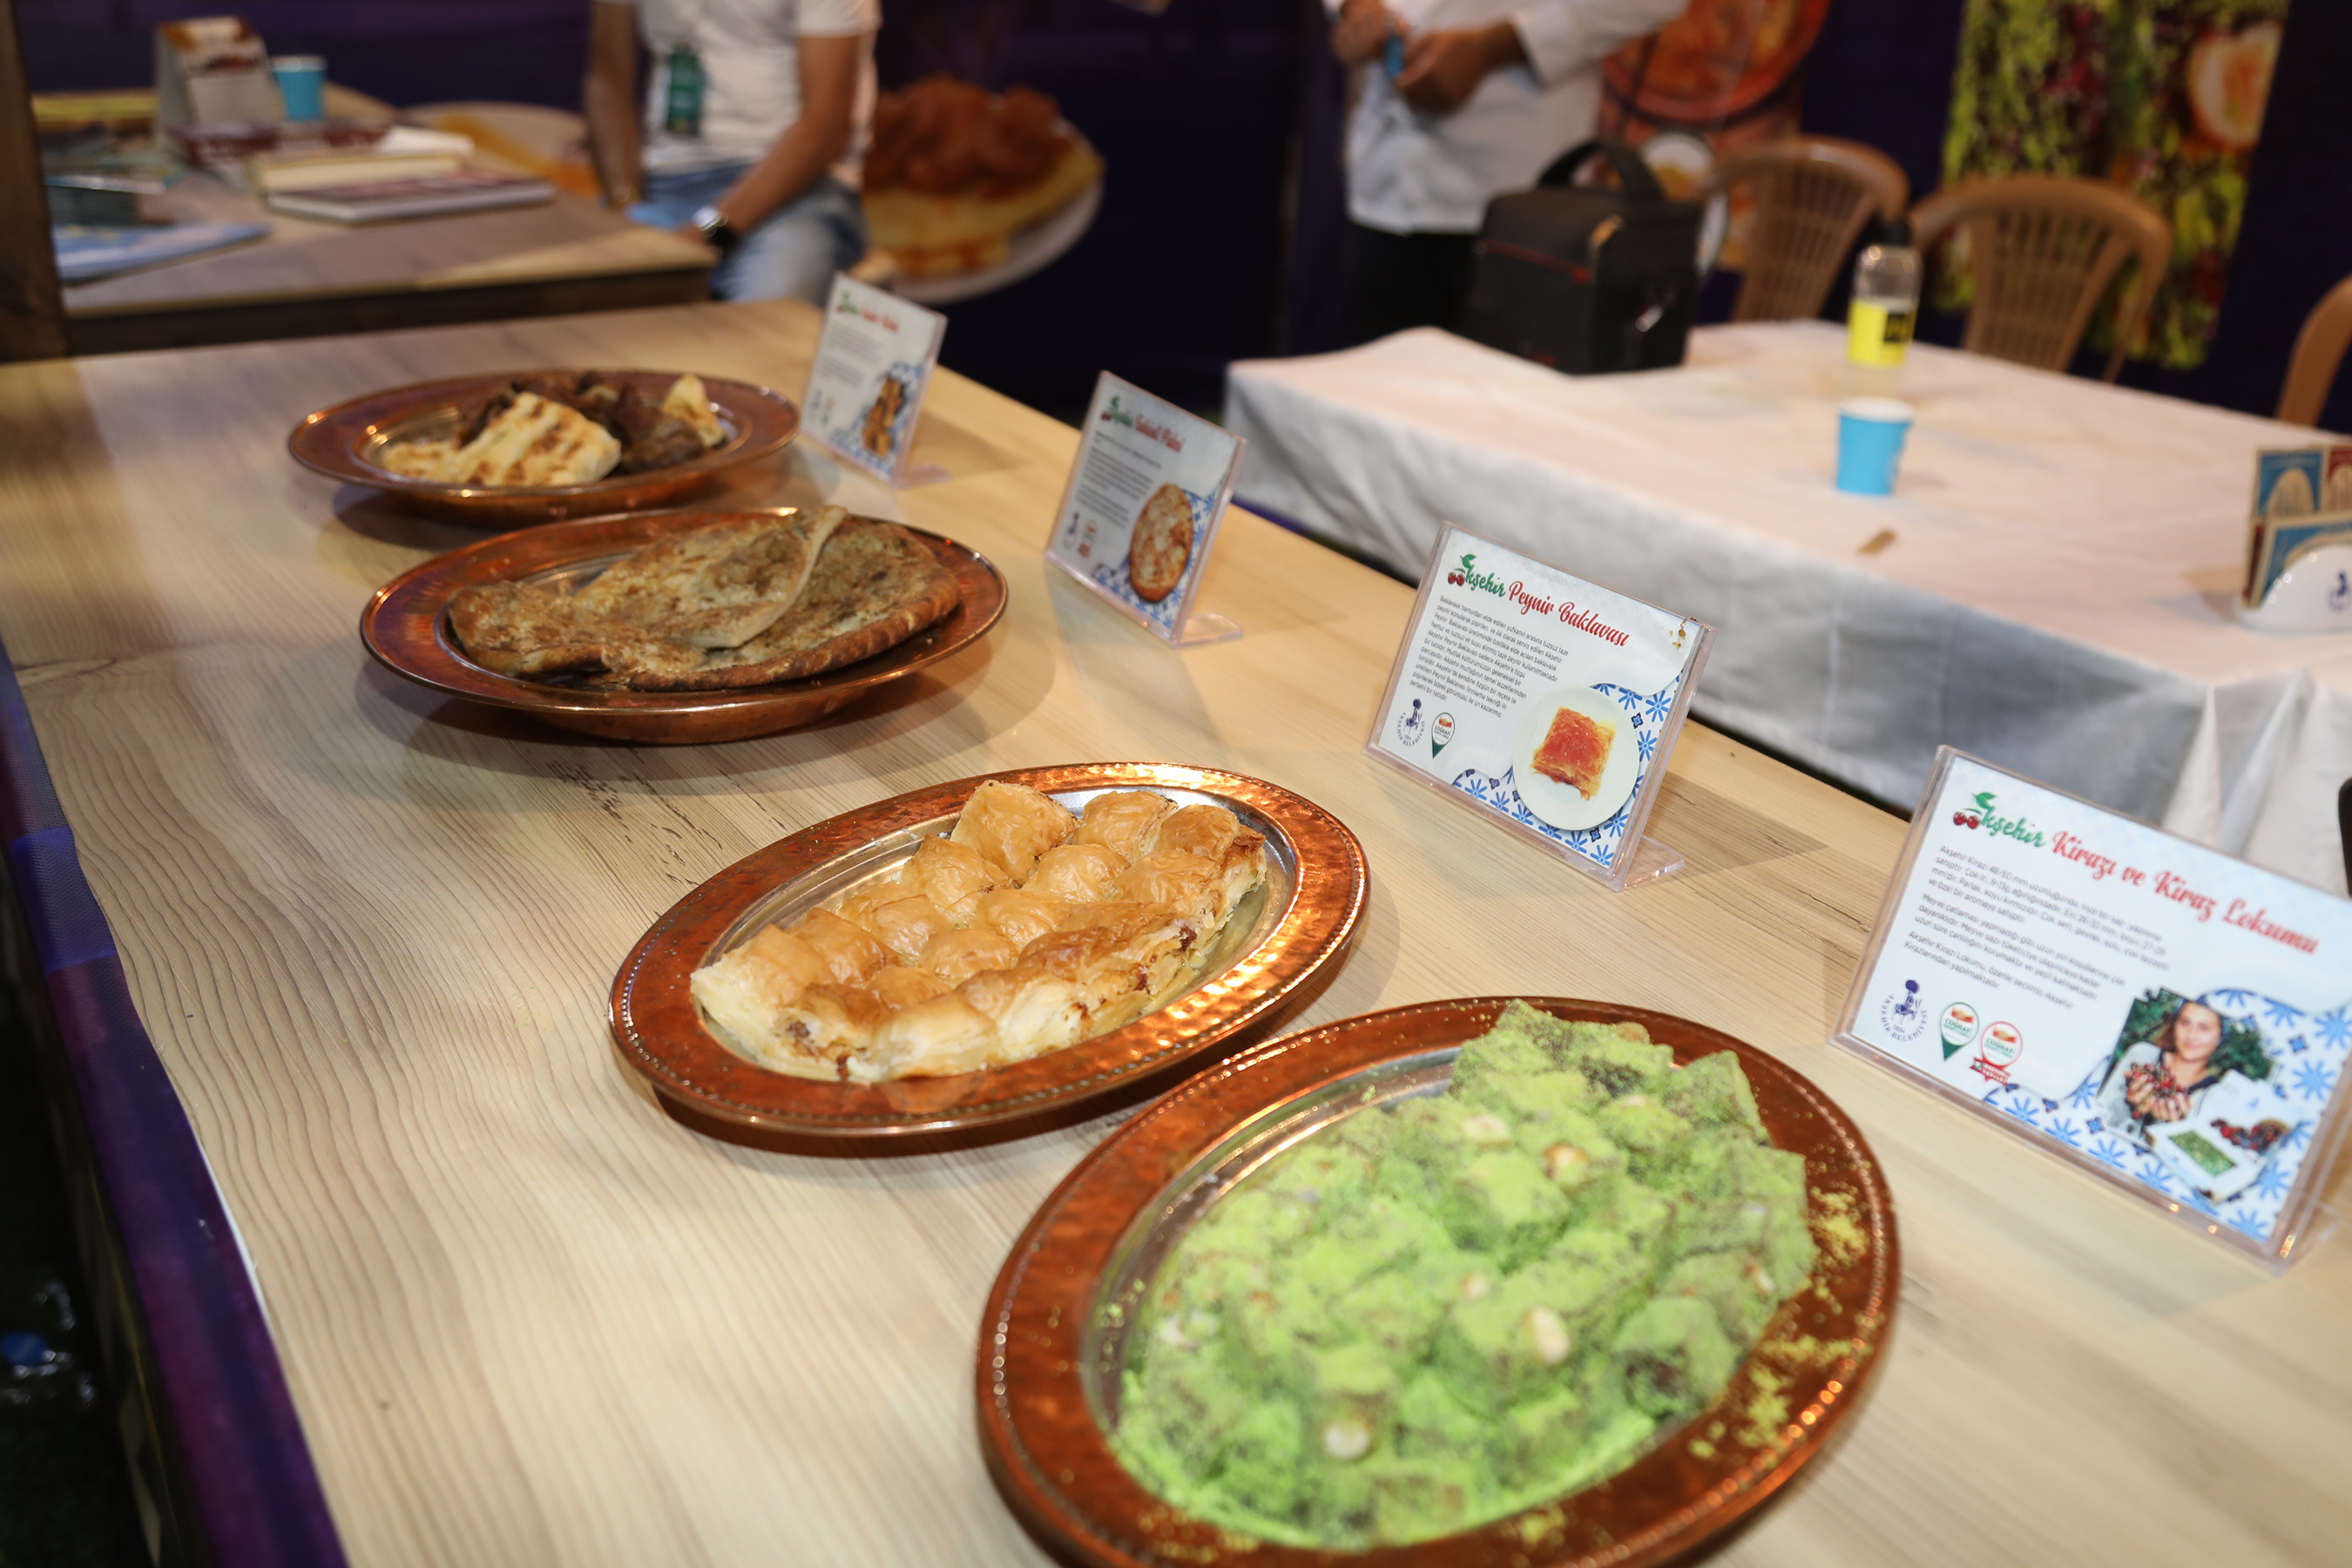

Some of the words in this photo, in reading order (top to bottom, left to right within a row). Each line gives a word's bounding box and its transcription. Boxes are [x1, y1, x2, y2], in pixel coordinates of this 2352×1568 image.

[1436, 605, 1450, 614] peynir
[1450, 610, 1470, 623] konularak
[1502, 632, 1516, 643] olarak
[1516, 639, 1530, 649] servis
[1530, 645, 1544, 655] edilen
[1544, 651, 1562, 663] Akşehir
[1440, 595, 1460, 609] Baklavalık
[1461, 605, 1483, 618] hamurdan
[1483, 614, 1492, 623] elde
[1492, 618, 1506, 629] edilen
[1506, 625, 1525, 637] yufkanın
[1525, 632, 1542, 645] arasına
[1542, 639, 1558, 651] tuzsuz
[1558, 646, 1568, 656] taze
[1508, 580, 1554, 615] Peynir
[1558, 601, 1629, 646] Baklavası
[1427, 629, 1443, 640] Akşehir
[1443, 636, 1457, 646] Peynir
[1457, 642, 1478, 656] Baklavası
[1478, 652, 1493, 663] sadece
[1493, 659, 1514, 672] Akşehir'e
[1513, 668, 1525, 678] özgü
[1430, 620, 1444, 631] hamur
[1450, 629, 1464, 640] tuzsuz
[1470, 639, 1482, 648] suyu
[1481, 644, 1497, 655] alınmış
[1497, 650, 1507, 659] taze
[1507, 655, 1522, 666] peynir
[1521, 661, 1558, 682] kullanılmaktadır.
[1430, 640, 1445, 652] tatlıdır.
[1446, 647, 1461, 658] Mutfak
[1461, 654, 1491, 672] kültürümüzün
[1491, 668, 1515, 683] geleneksel
[1434, 612, 1447, 622] Peynir
[1448, 618, 1468, 632] Baklavası
[1468, 627, 1492, 642] üretiminde
[1492, 638, 1510, 650] özellikle
[1510, 646, 1520, 655] elde
[1519, 651, 1534, 660] açılan
[1533, 657, 1556, 671] baklavalık
[1412, 671, 1433, 685] pişirilerek
[1433, 680, 1445, 691] börek
[1446, 686, 1468, 701] görüntüsü
[1480, 703, 1501, 717] kazanmış
[1415, 663, 1432, 674] üretilen
[1432, 670, 1446, 680] Peynir
[1446, 676, 1465, 690] Baklavası
[1465, 686, 1485, 700] fırınlama
[1485, 695, 1501, 707] tekniği
[1432, 690, 1447, 700] tatlıdır.
[1436, 662, 1457, 677] Akşehir'de
[1457, 672, 1475, 685] kendine
[1475, 680, 1490, 691] özgün
[1497, 691, 1511, 701] reçete
[1443, 656, 1459, 667] Akşehir
[1459, 664, 1483, 679] mutfağının
[1483, 674, 1497, 685] temel
[1497, 680, 1526, 699] lezzetlerinden
[2051, 830, 2117, 880] Kirazı
[2121, 866, 2146, 886] ve
[2154, 870, 2216, 922] Kiraz
[2222, 898, 2317, 954] Lokumu
